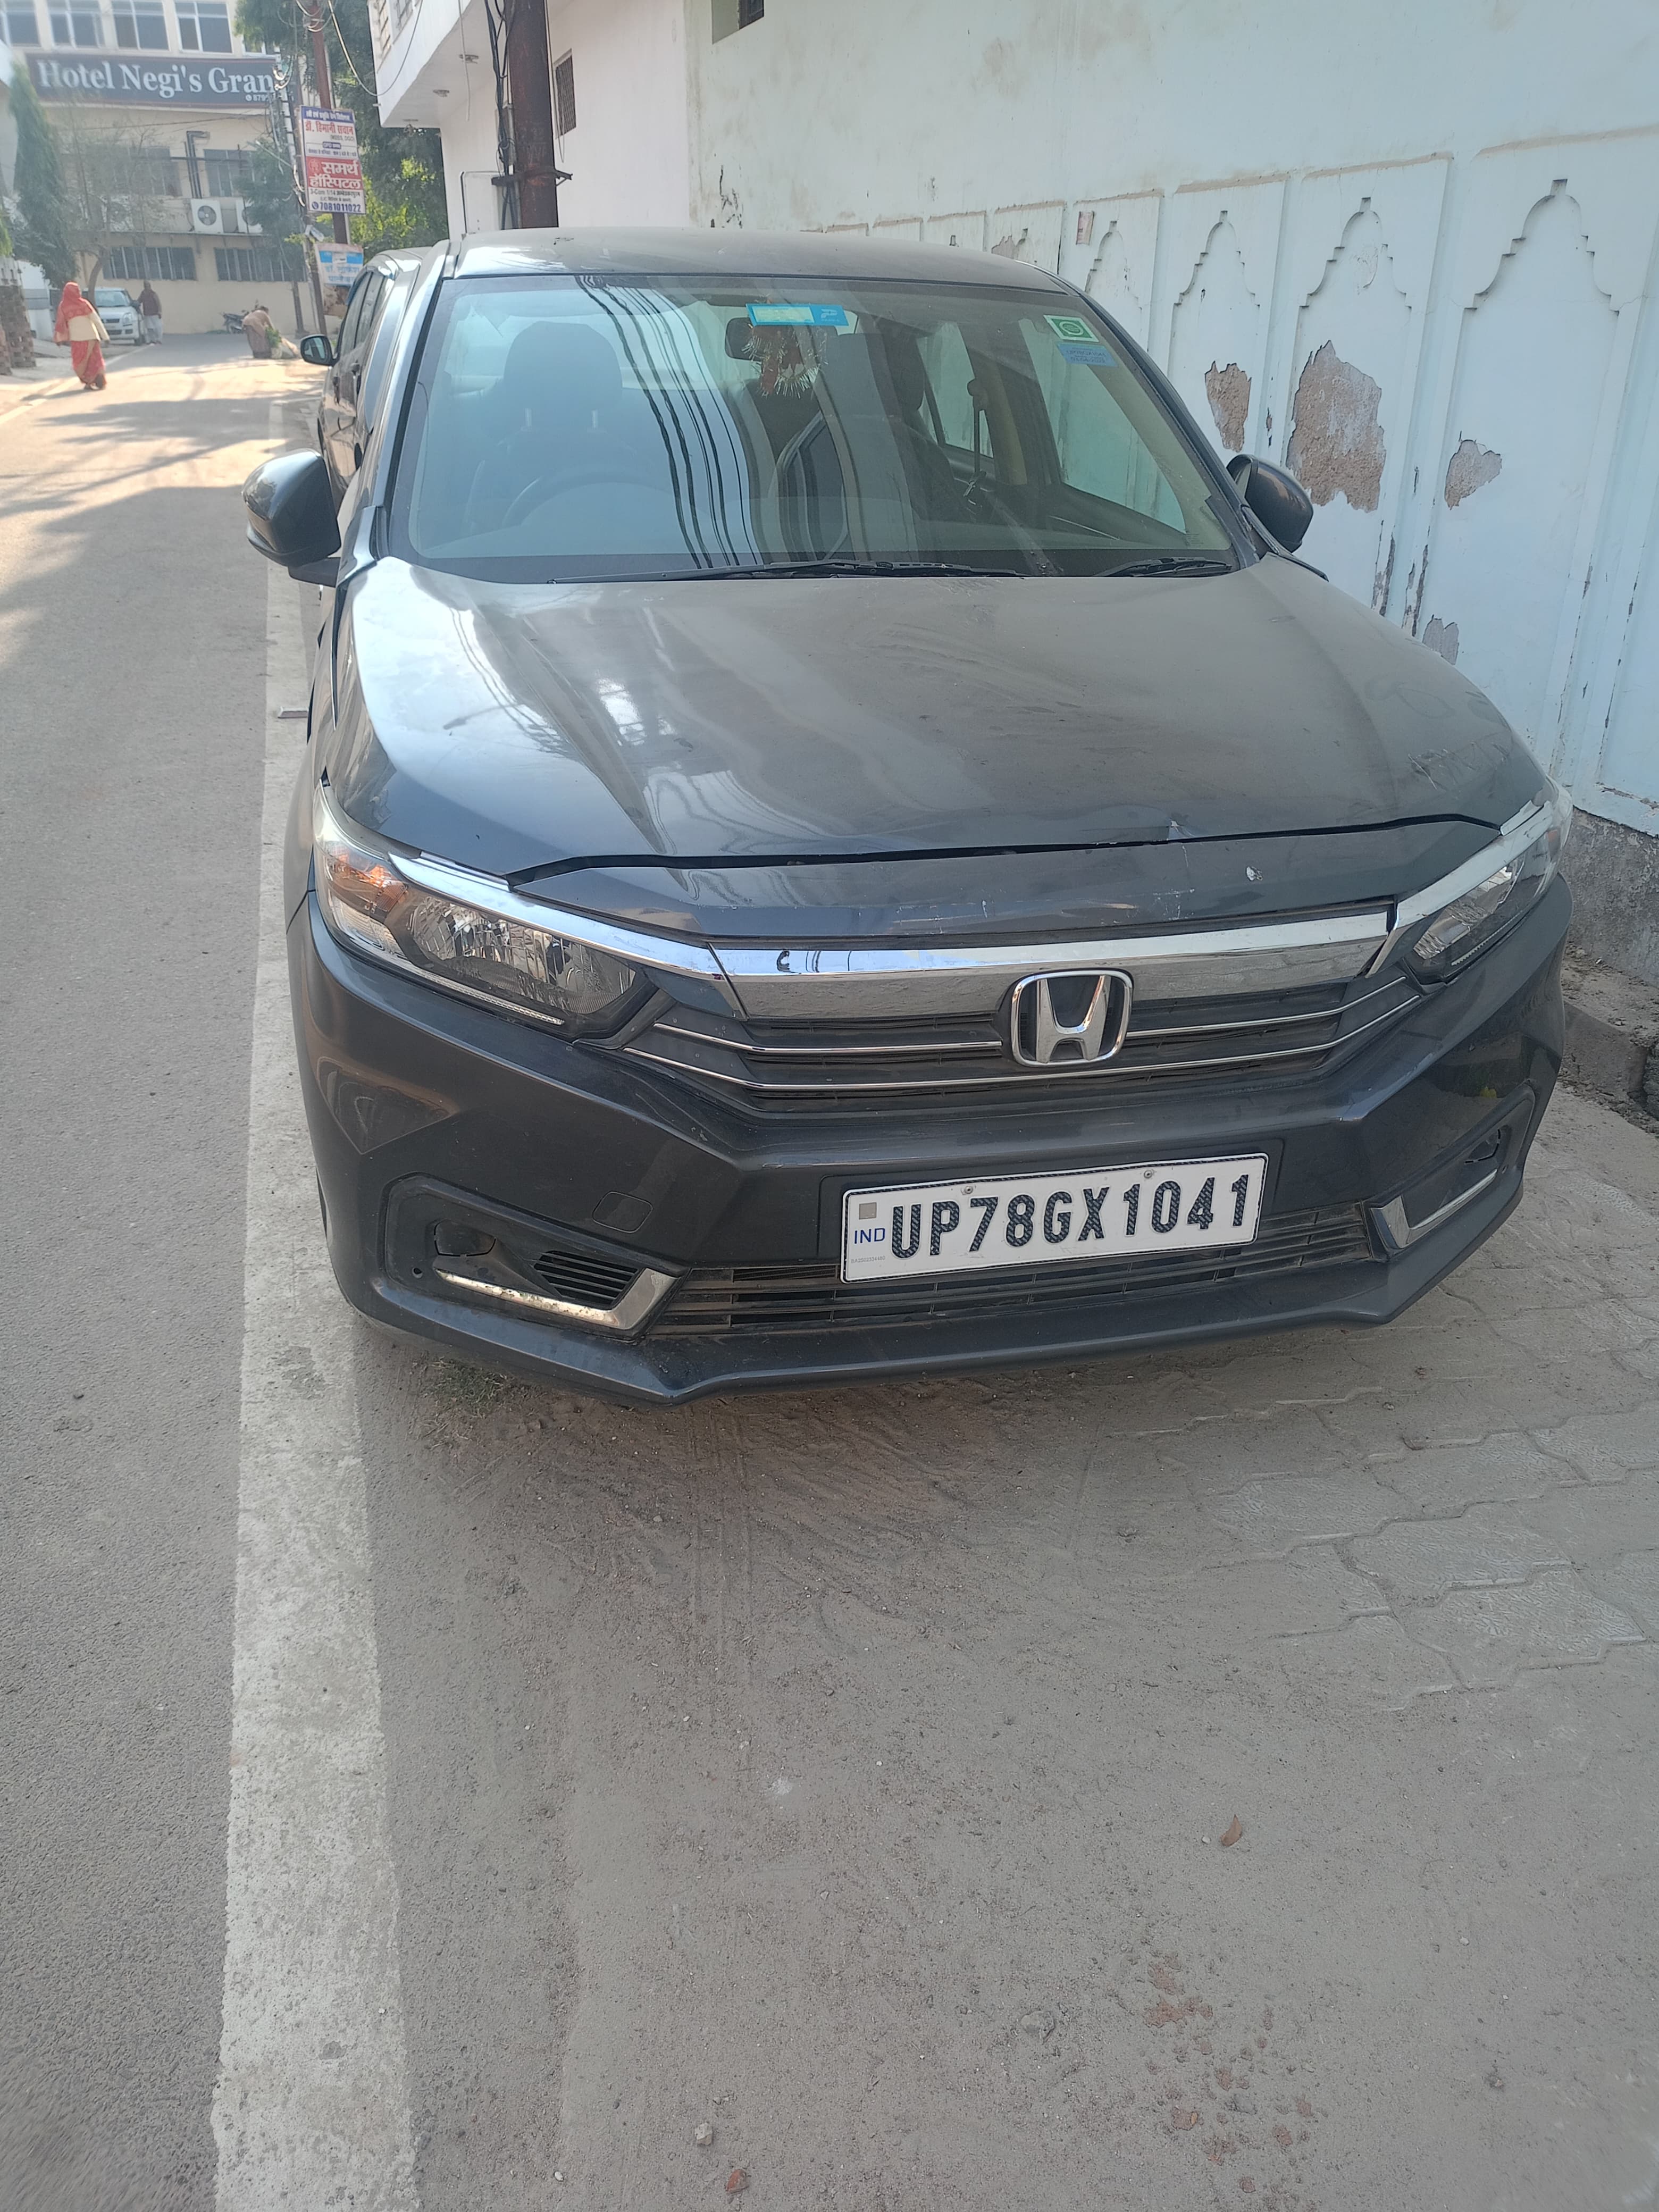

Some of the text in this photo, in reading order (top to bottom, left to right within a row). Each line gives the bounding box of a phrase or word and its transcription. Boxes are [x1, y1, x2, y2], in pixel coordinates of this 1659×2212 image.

[37, 60, 276, 98] Hotel Negi's Gran
[321, 160, 359, 175] समर्थ
[309, 173, 362, 189] हॉस्पिटल
[320, 202, 362, 212] 7081011022
[891, 1174, 1250, 1259] UP78GX1041
[854, 1227, 886, 1244] IND
